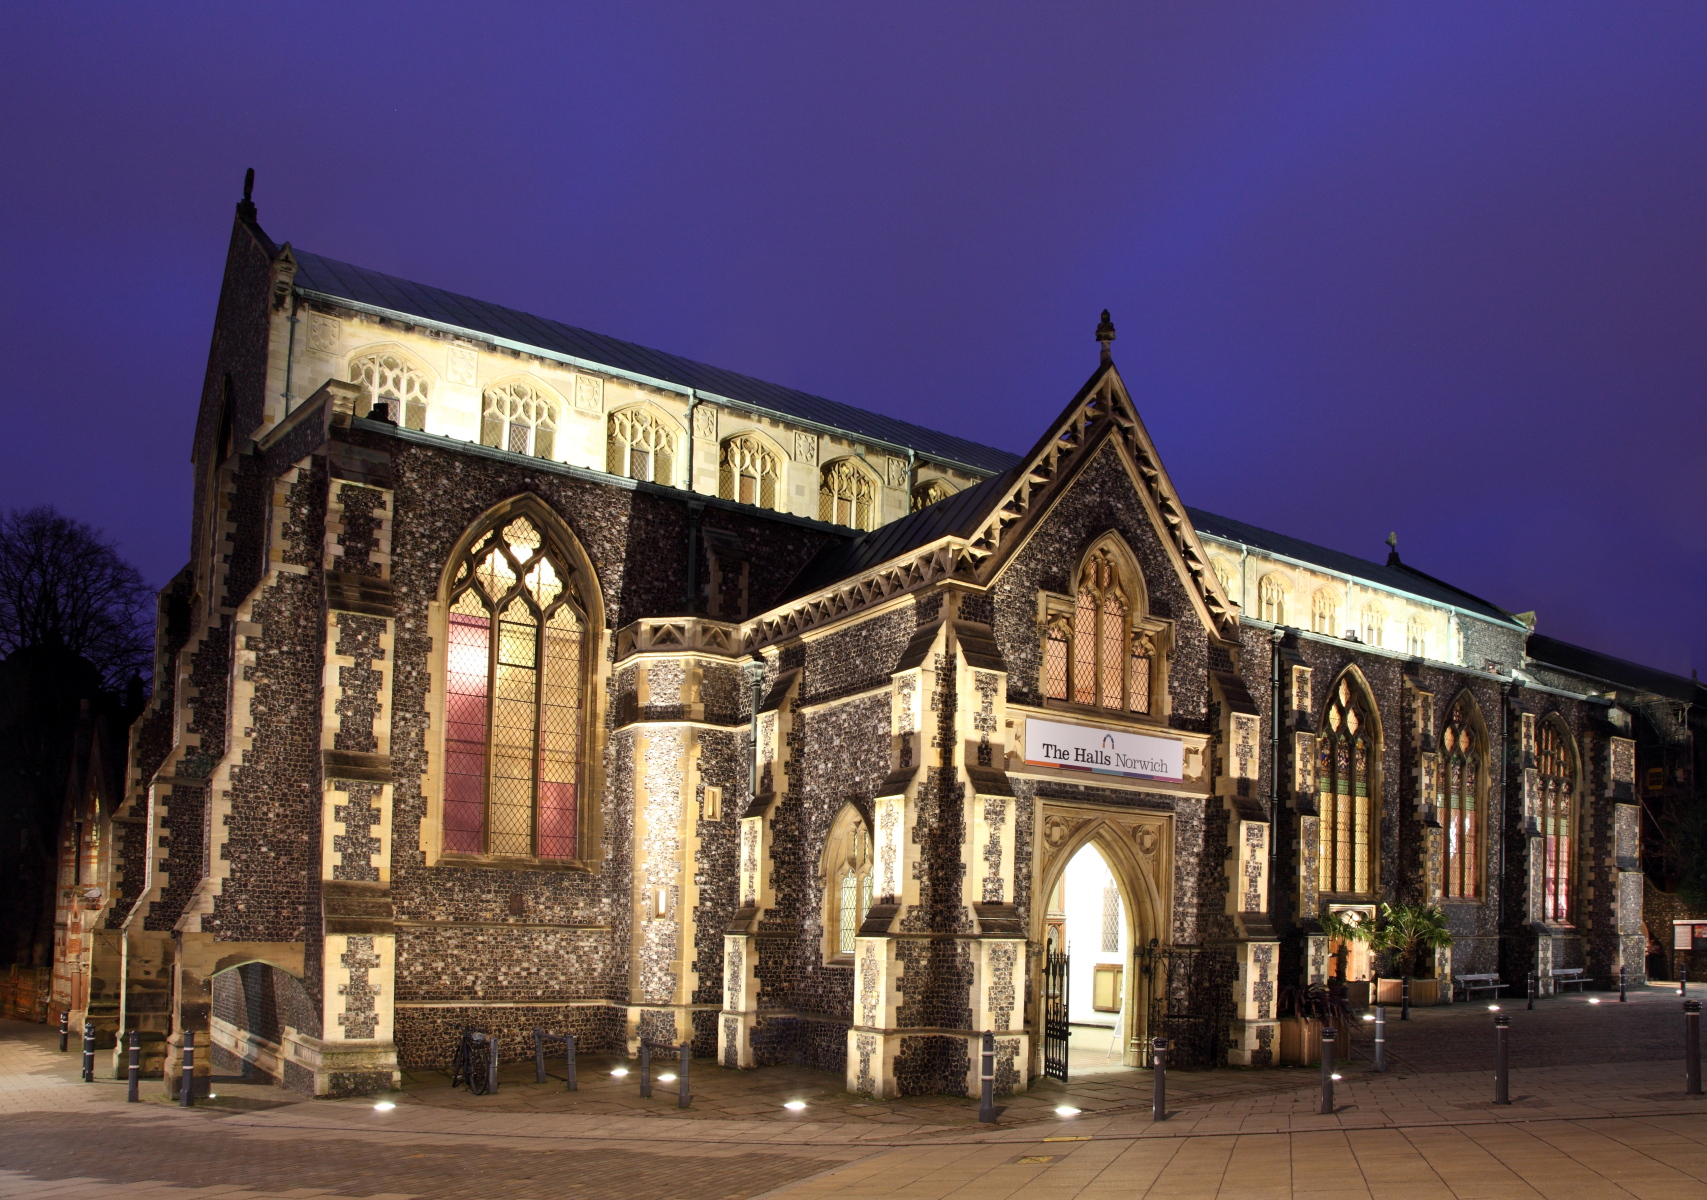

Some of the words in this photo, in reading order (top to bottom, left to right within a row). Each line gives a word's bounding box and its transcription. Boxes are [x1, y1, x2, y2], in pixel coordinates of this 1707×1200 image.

[1042, 743, 1070, 760] The
[1074, 747, 1111, 765] Halls
[1115, 753, 1168, 773] Norwich
